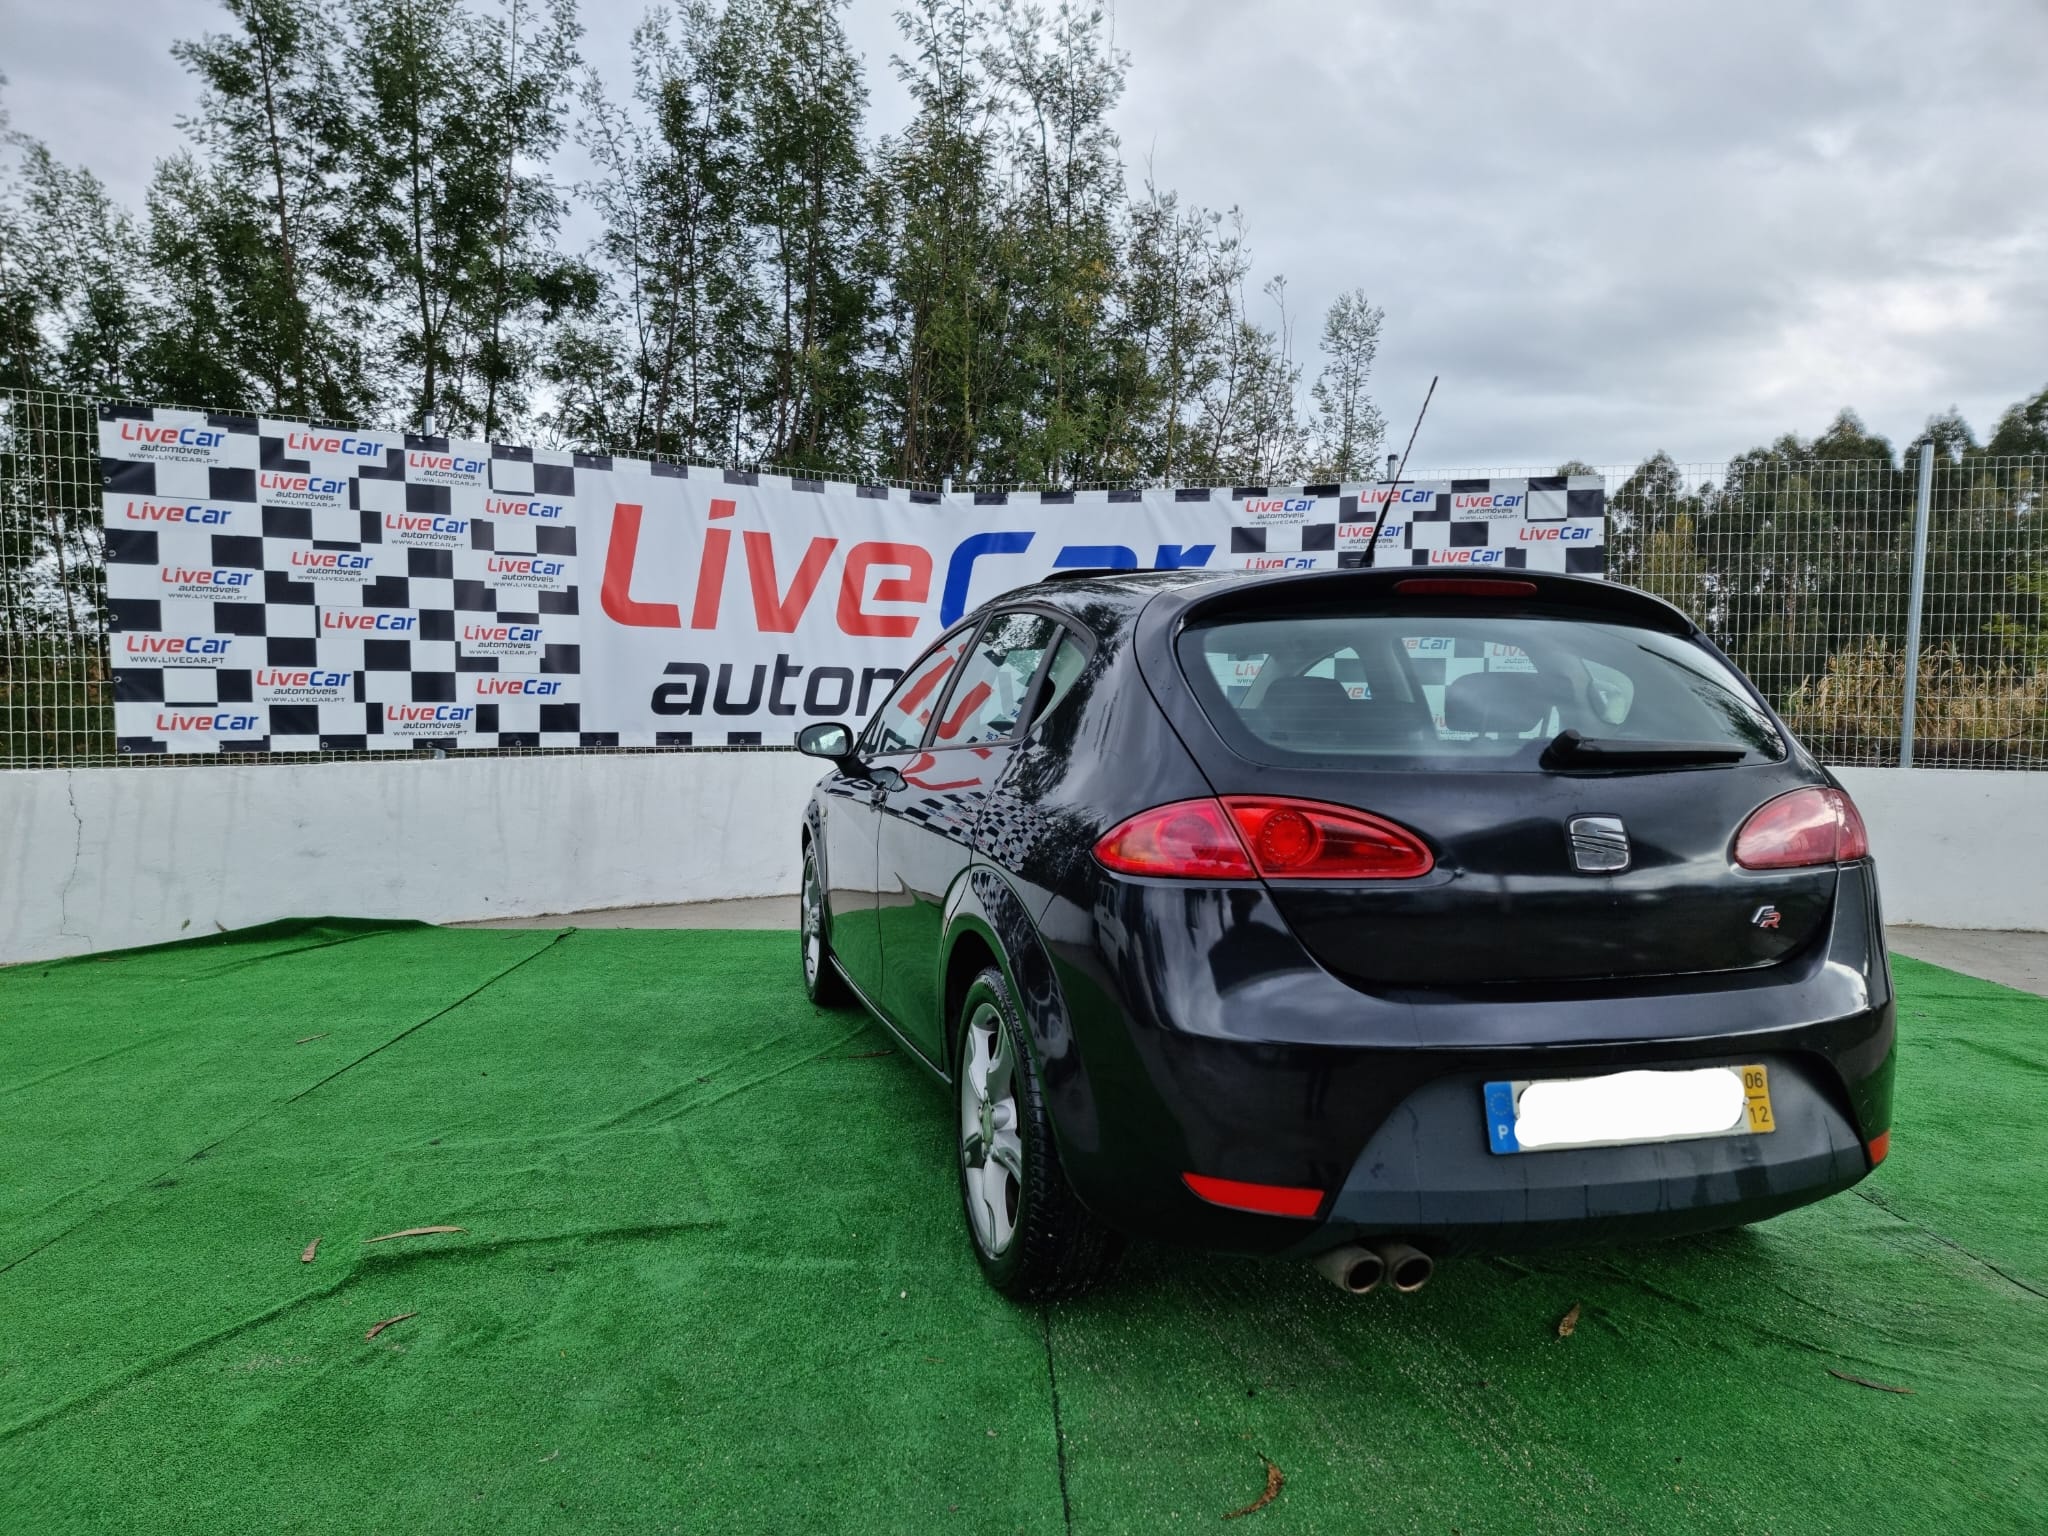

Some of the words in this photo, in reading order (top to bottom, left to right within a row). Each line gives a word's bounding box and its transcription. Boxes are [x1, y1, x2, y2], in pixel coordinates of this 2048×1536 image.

[121, 423, 225, 447] LiveCar
[140, 444, 210, 456] automóveis
[288, 433, 384, 456] LiveCar
[410, 453, 486, 474] LiveCar
[424, 469, 475, 480] automóveis
[260, 473, 347, 494] LiveCar
[276, 491, 334, 501] automóveis
[1361, 489, 1434, 503] LiveCar
[1455, 494, 1524, 508] LiveCar
[126, 501, 232, 525] LiveCar
[486, 498, 563, 518] LiveCar
[1245, 499, 1316, 512] LiveCar
[385, 514, 469, 534] LiveCar
[401, 531, 457, 541] automóveis
[1519, 526, 1593, 541] LiveCar
[291, 551, 373, 568] LiveCar
[1431, 549, 1503, 563] LiveCar
[307, 567, 361, 576] automóveis
[488, 557, 565, 576] LiveCar
[600, 498, 1216, 638] LiveC
[162, 566, 253, 586] LiveCar
[502, 573, 554, 583] automóveis
[178, 584, 240, 594] automóveis
[324, 611, 416, 630] LiveCar
[464, 625, 543, 642] LiveCar
[126, 634, 232, 654] LiveCar
[478, 640, 531, 649] automóveis
[130, 656, 225, 665] WWW.LIVECAR.PT
[256, 669, 351, 687] LiveCar
[476, 678, 561, 695] LiveCar
[274, 687, 338, 695] automóveis
[387, 704, 474, 721] LiveCar
[156, 713, 259, 731] LiveCar
[403, 721, 462, 729] automóveis
[1751, 905, 1781, 929] FR
[1744, 1072, 1764, 1089] 06
[1750, 1106, 1770, 1124] 12
[1497, 1124, 1509, 1140] P
